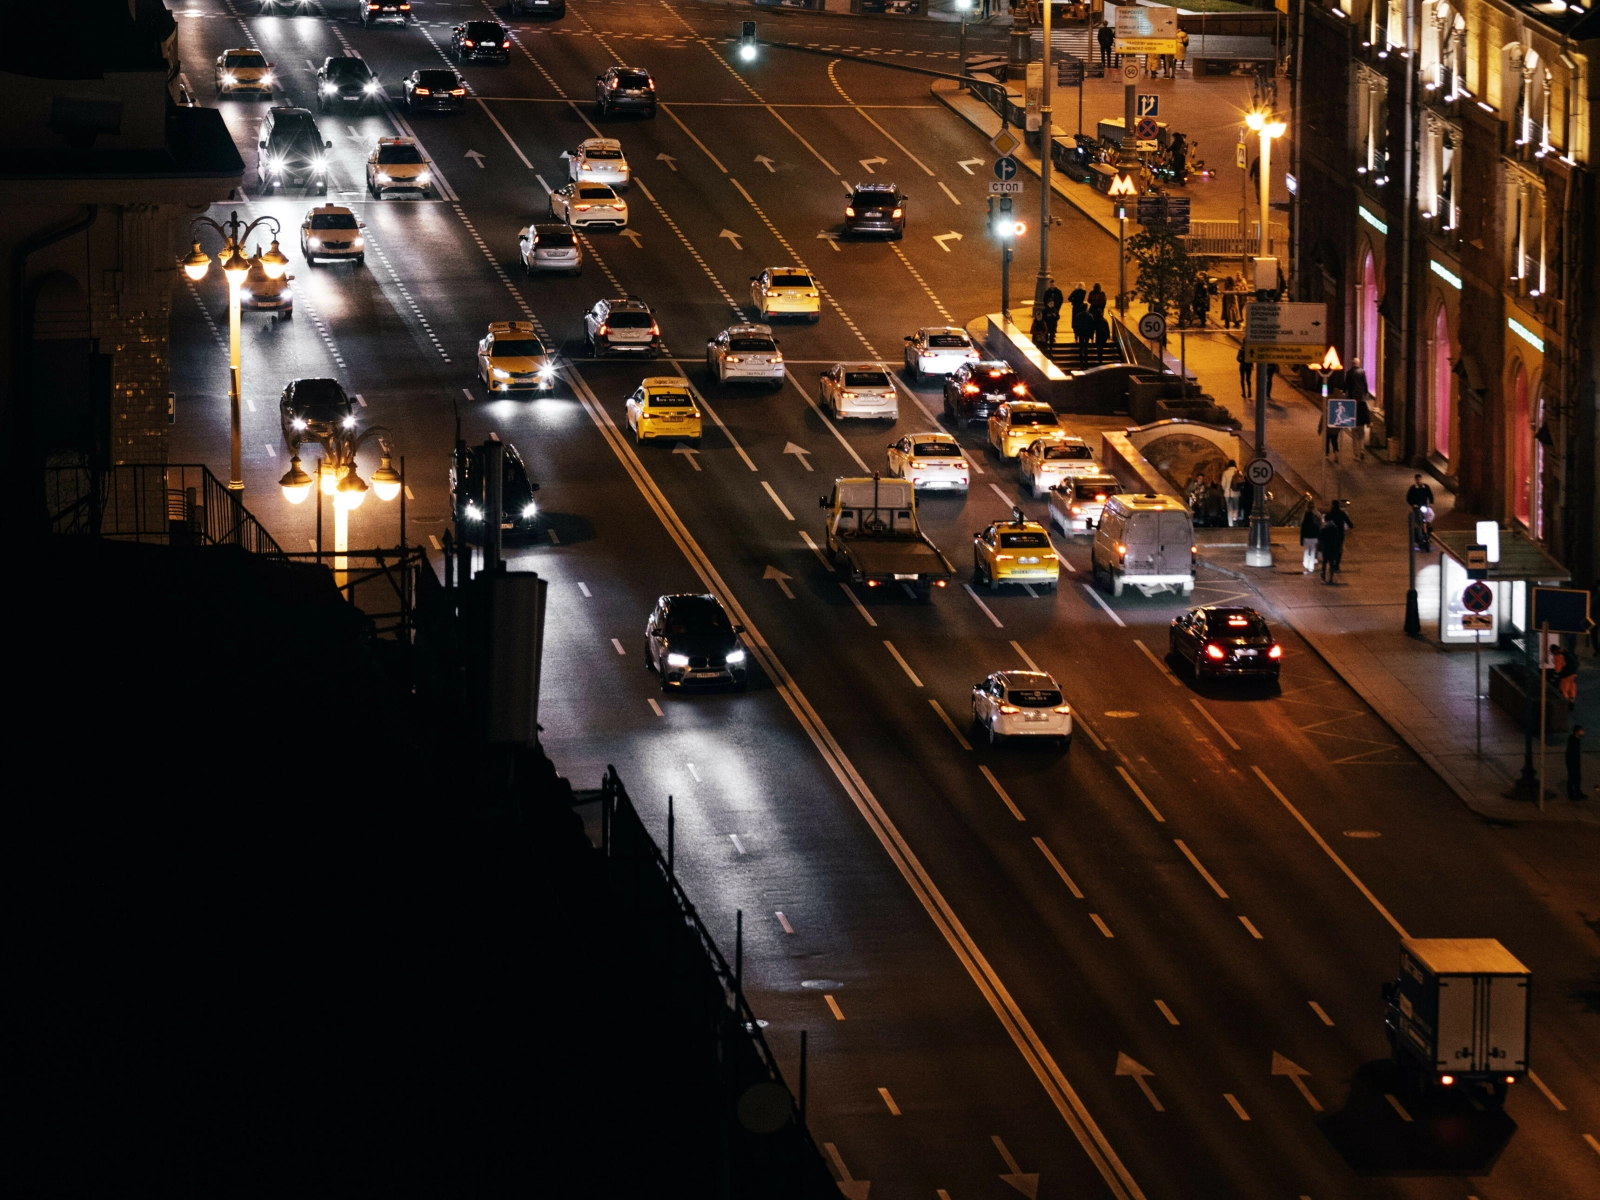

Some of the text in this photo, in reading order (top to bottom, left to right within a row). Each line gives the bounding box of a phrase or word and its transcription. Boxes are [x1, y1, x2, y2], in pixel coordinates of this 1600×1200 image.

[992, 183, 1019, 191] СТОП
[1145, 321, 1161, 333] 50
[1253, 467, 1268, 478] 50
